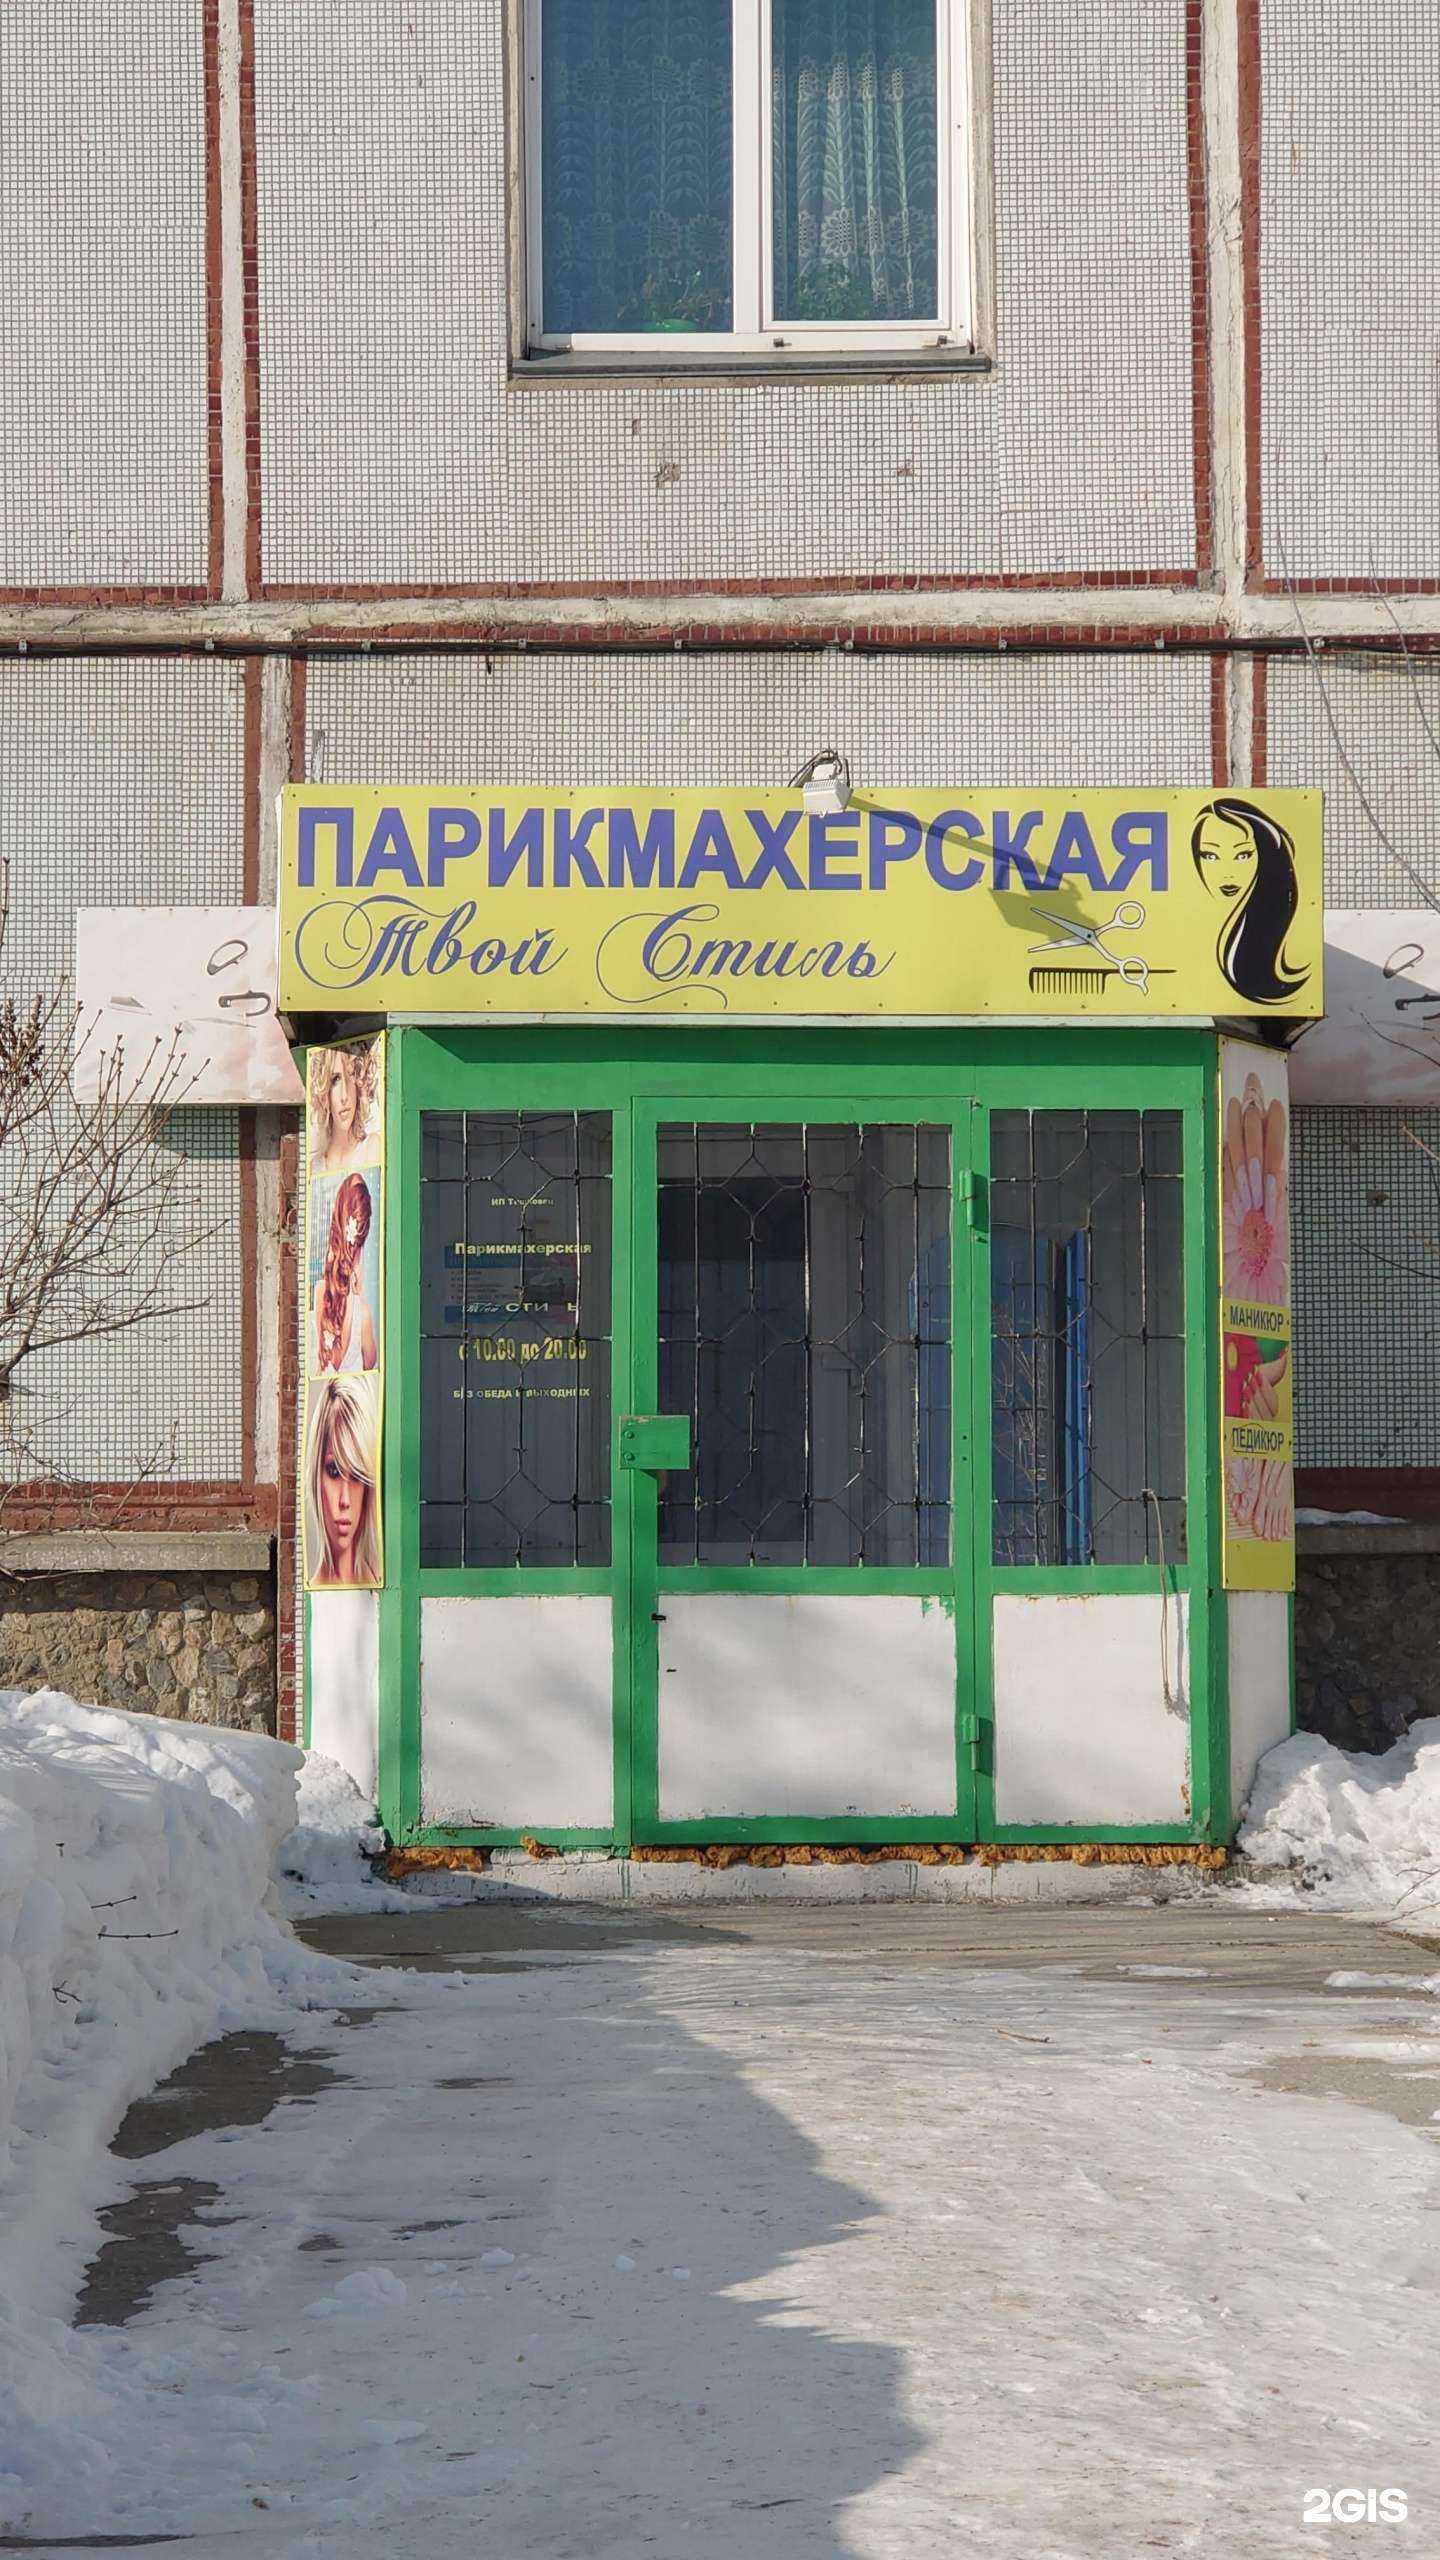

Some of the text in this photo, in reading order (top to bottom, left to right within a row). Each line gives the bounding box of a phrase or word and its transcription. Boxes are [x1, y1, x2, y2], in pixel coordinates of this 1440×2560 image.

[297, 807, 1169, 892] ПАРИКМАХЕРСКАЯ
[294, 894, 897, 1009] Твой Стиль
[505, 1302, 581, 1312] СТИЬ
[1230, 1305, 1284, 1332] МАНИКЮР
[1232, 1427, 1285, 1452] ПЕДИКЮР
